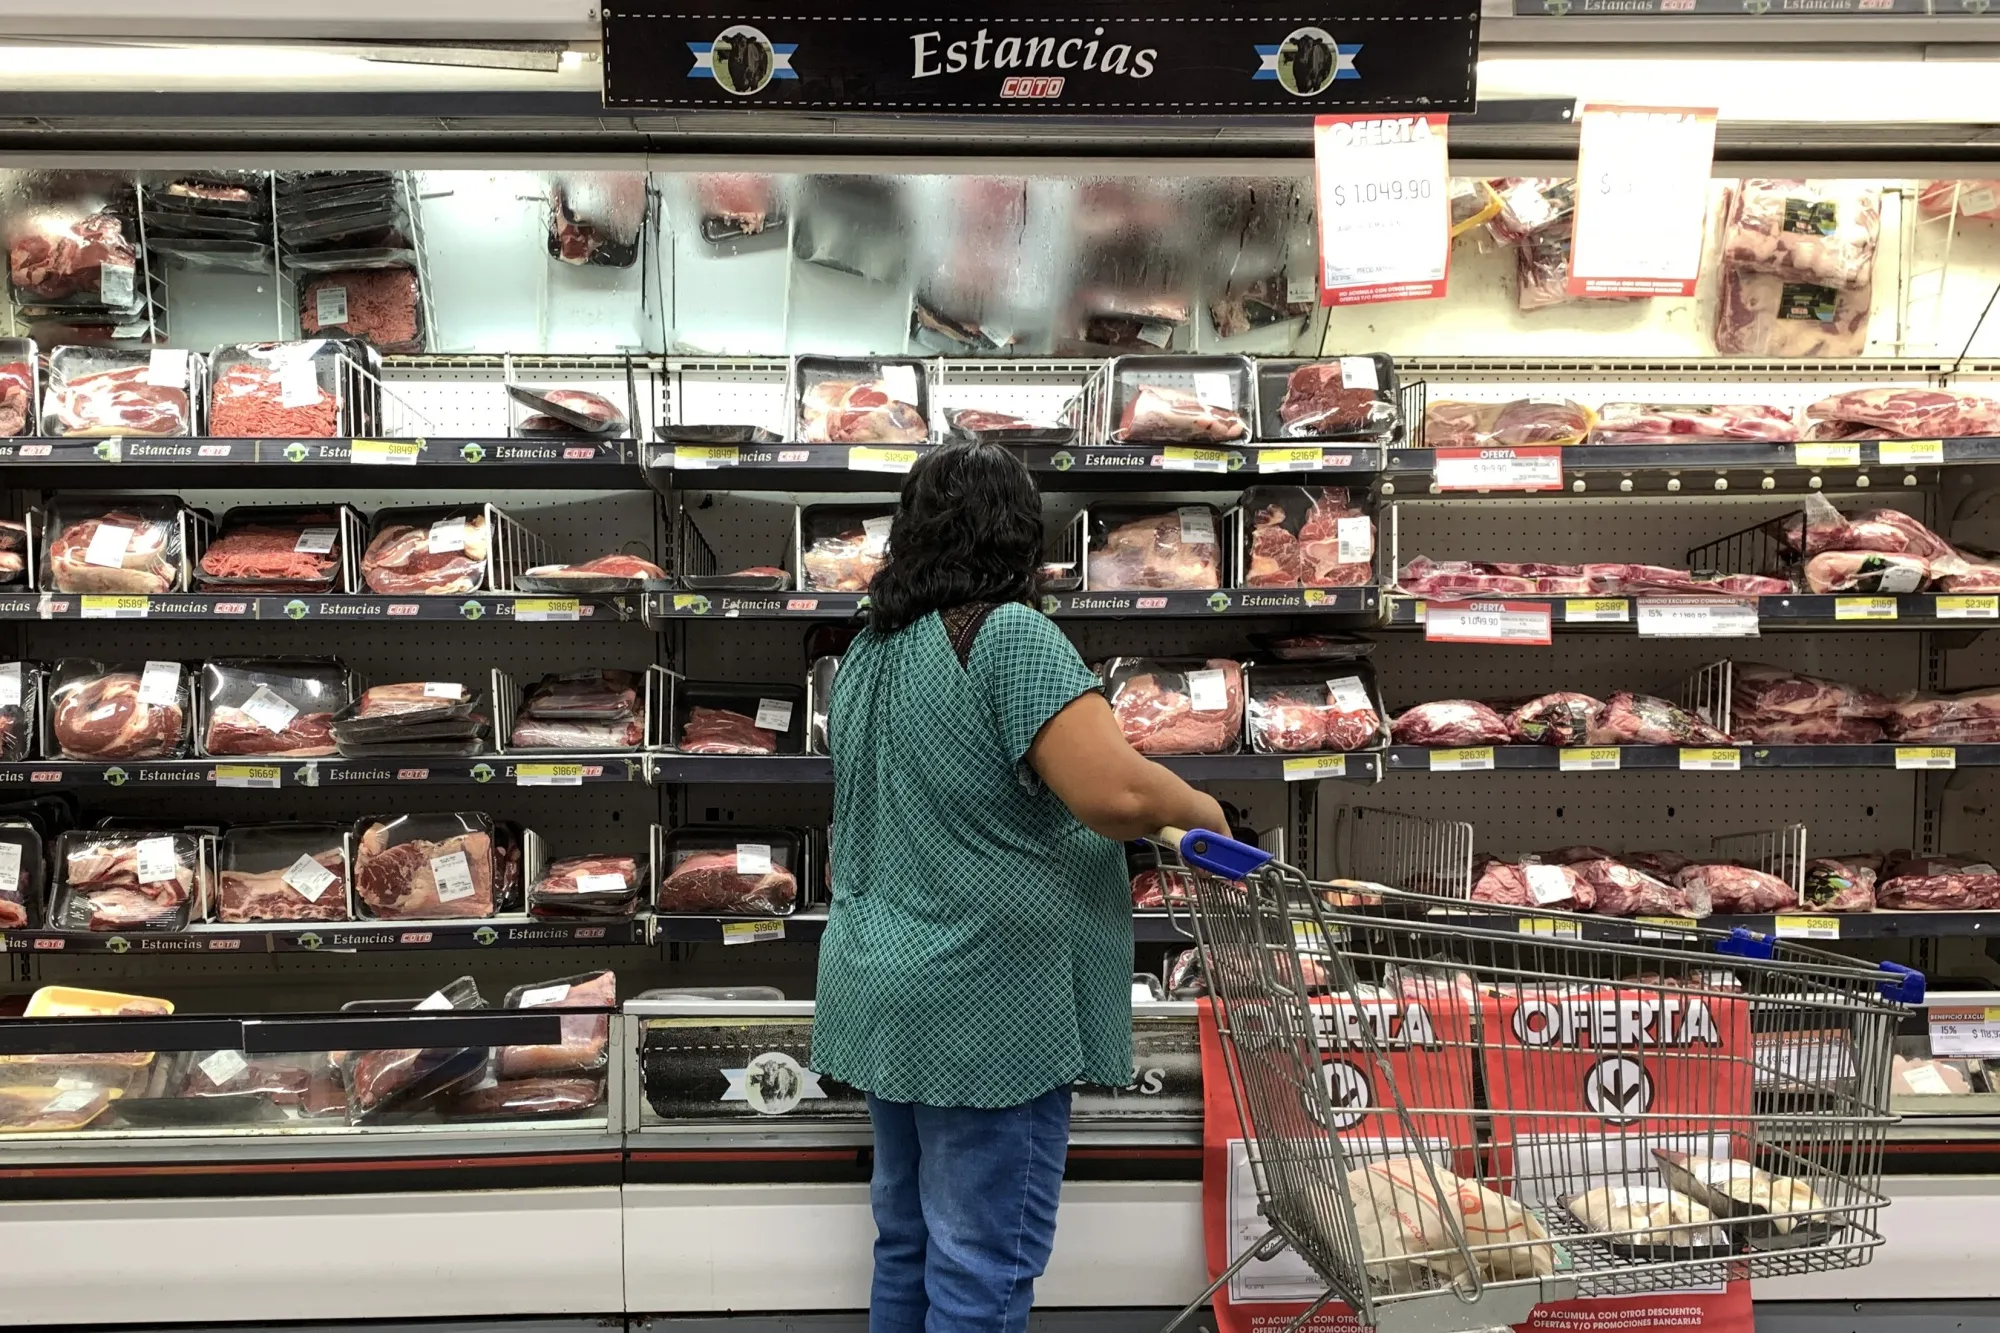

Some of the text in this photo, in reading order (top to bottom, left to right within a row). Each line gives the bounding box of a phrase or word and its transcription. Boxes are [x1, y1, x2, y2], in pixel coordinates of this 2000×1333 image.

[1584, 0, 1653, 11] Estancias
[910, 27, 1158, 78] Estancias
[1000, 76, 1065, 98] COTO
[1328, 116, 1433, 147] OFERTA
[1334, 185, 1346, 207] $
[18, 445, 52, 456] COTO
[129, 444, 231, 457] Estancias COTO
[388, 444, 413, 455] $1849
[495, 445, 596, 459] Estancias COTO
[708, 448, 732, 459] $1849
[1480, 449, 1517, 460] OFERTA
[738, 450, 809, 462] ncias COTO
[1085, 453, 1145, 466] Estancias
[1193, 450, 1220, 461] $2089
[1290, 451, 1315, 462] $2169
[1323, 455, 1352, 467] COTO
[117, 598, 142, 609] $1589
[548, 601, 573, 612] $1869
[721, 598, 819, 611] Estancias COTO
[1071, 597, 1168, 610] Estancias COTO
[1241, 594, 1301, 608] Estancias
[1595, 601, 1621, 612] $2589
[1965, 598, 1991, 609] $2349
[147, 601, 247, 614] Estancias COTO
[319, 603, 419, 616] Estancias COTO
[1470, 602, 1506, 613] OFERTA
[1648, 609, 1663, 618] 15%
[1461, 616, 1466, 625] $
[1459, 750, 1486, 760] $2639
[1590, 750, 1616, 761] $2779
[1711, 751, 1735, 761] $2519
[1317, 758, 1338, 769] $979
[139, 769, 201, 782] Estancias
[249, 768, 274, 778] $1669
[329, 769, 429, 781] Estancias COTO
[553, 766, 577, 776] $1869
[30, 771, 62, 783] COTO
[754, 922, 778, 933] $1969
[1807, 918, 1833, 929] $2589
[333, 932, 433, 945] Estancias COTO
[508, 927, 607, 940] Estancias COTO
[34, 938, 65, 950] COTO
[141, 938, 241, 950] Estancias COTO
[1511, 999, 1723, 1049] OFERTA
[1941, 1026, 1957, 1035] 15%
[1972, 1029, 1978, 1039] $
[1533, 1307, 1704, 1320] NO ACUMULA CON OTROS DESCUENTOS,
[1252, 1317, 1265, 1325] NO
[1313, 1315, 1335, 1324] CON
[1533, 1317, 1702, 1331] OFERTAS Y/O PROMOCIONES BANCARIAS
[1308, 1325, 1373, 1333] PROMOCIONES
